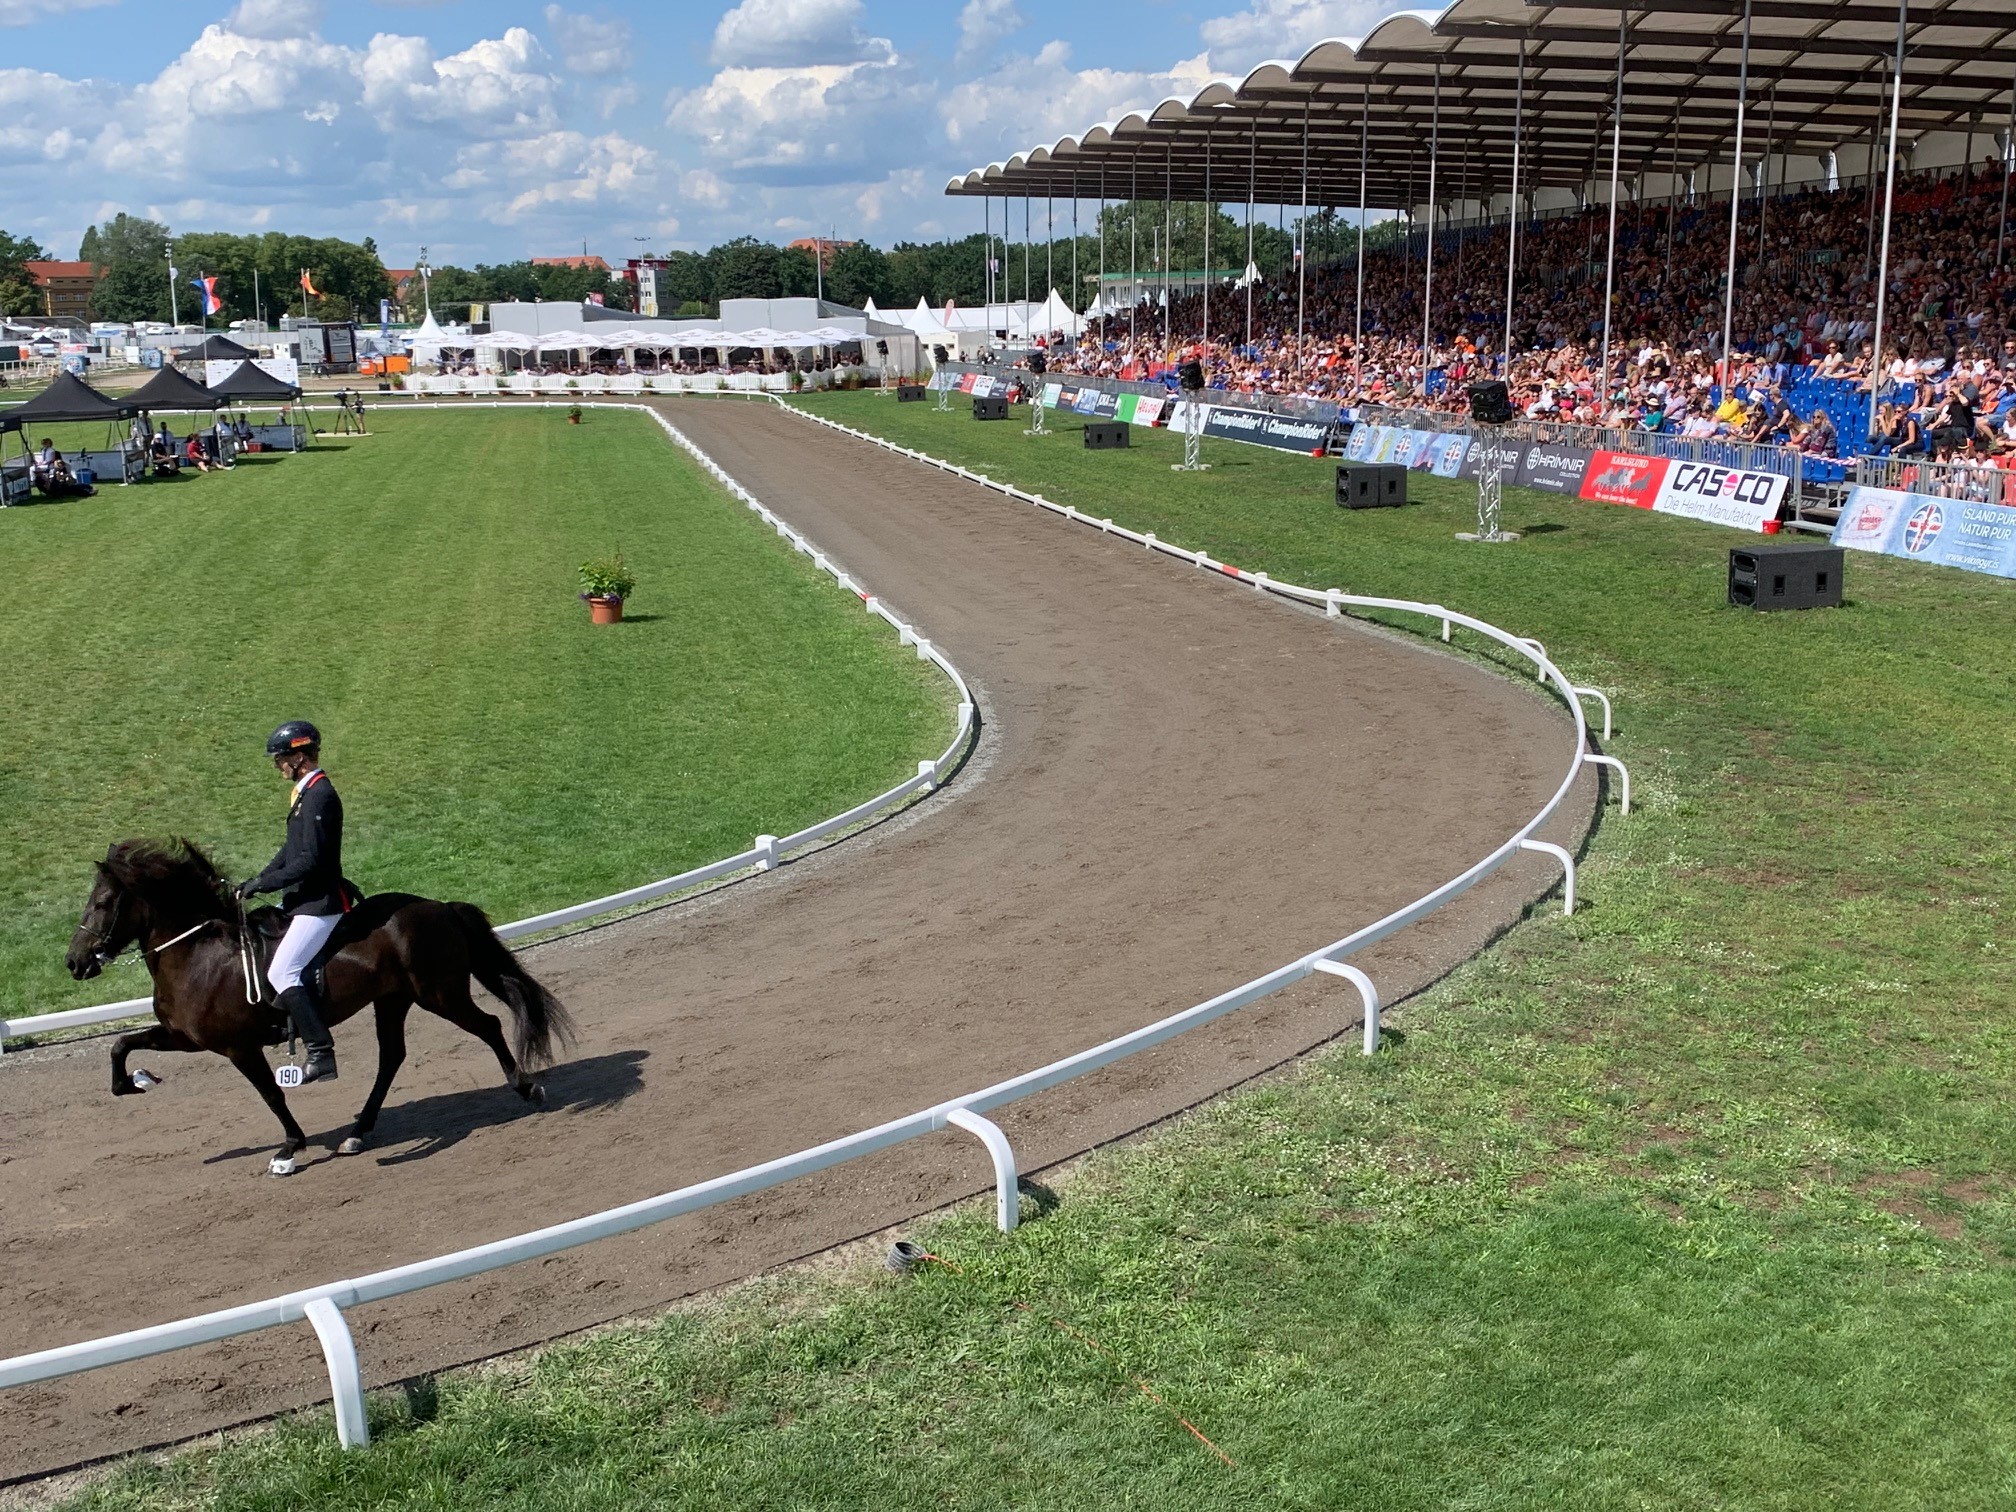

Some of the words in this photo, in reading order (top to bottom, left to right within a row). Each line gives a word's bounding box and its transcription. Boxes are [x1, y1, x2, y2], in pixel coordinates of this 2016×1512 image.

[1538, 453, 1585, 472] HRÍMNIR
[1610, 455, 1649, 468] KARLSLUND
[1672, 464, 1775, 506] CASCO
[1664, 495, 1680, 510] Die
[1682, 498, 1761, 526] Helm-Manufaktur
[1962, 507, 1996, 523] ISLAND
[1958, 522, 1991, 538] NATUR
[1945, 553, 2000, 569] www.vikingyr.is
[280, 1069, 298, 1084] 190
